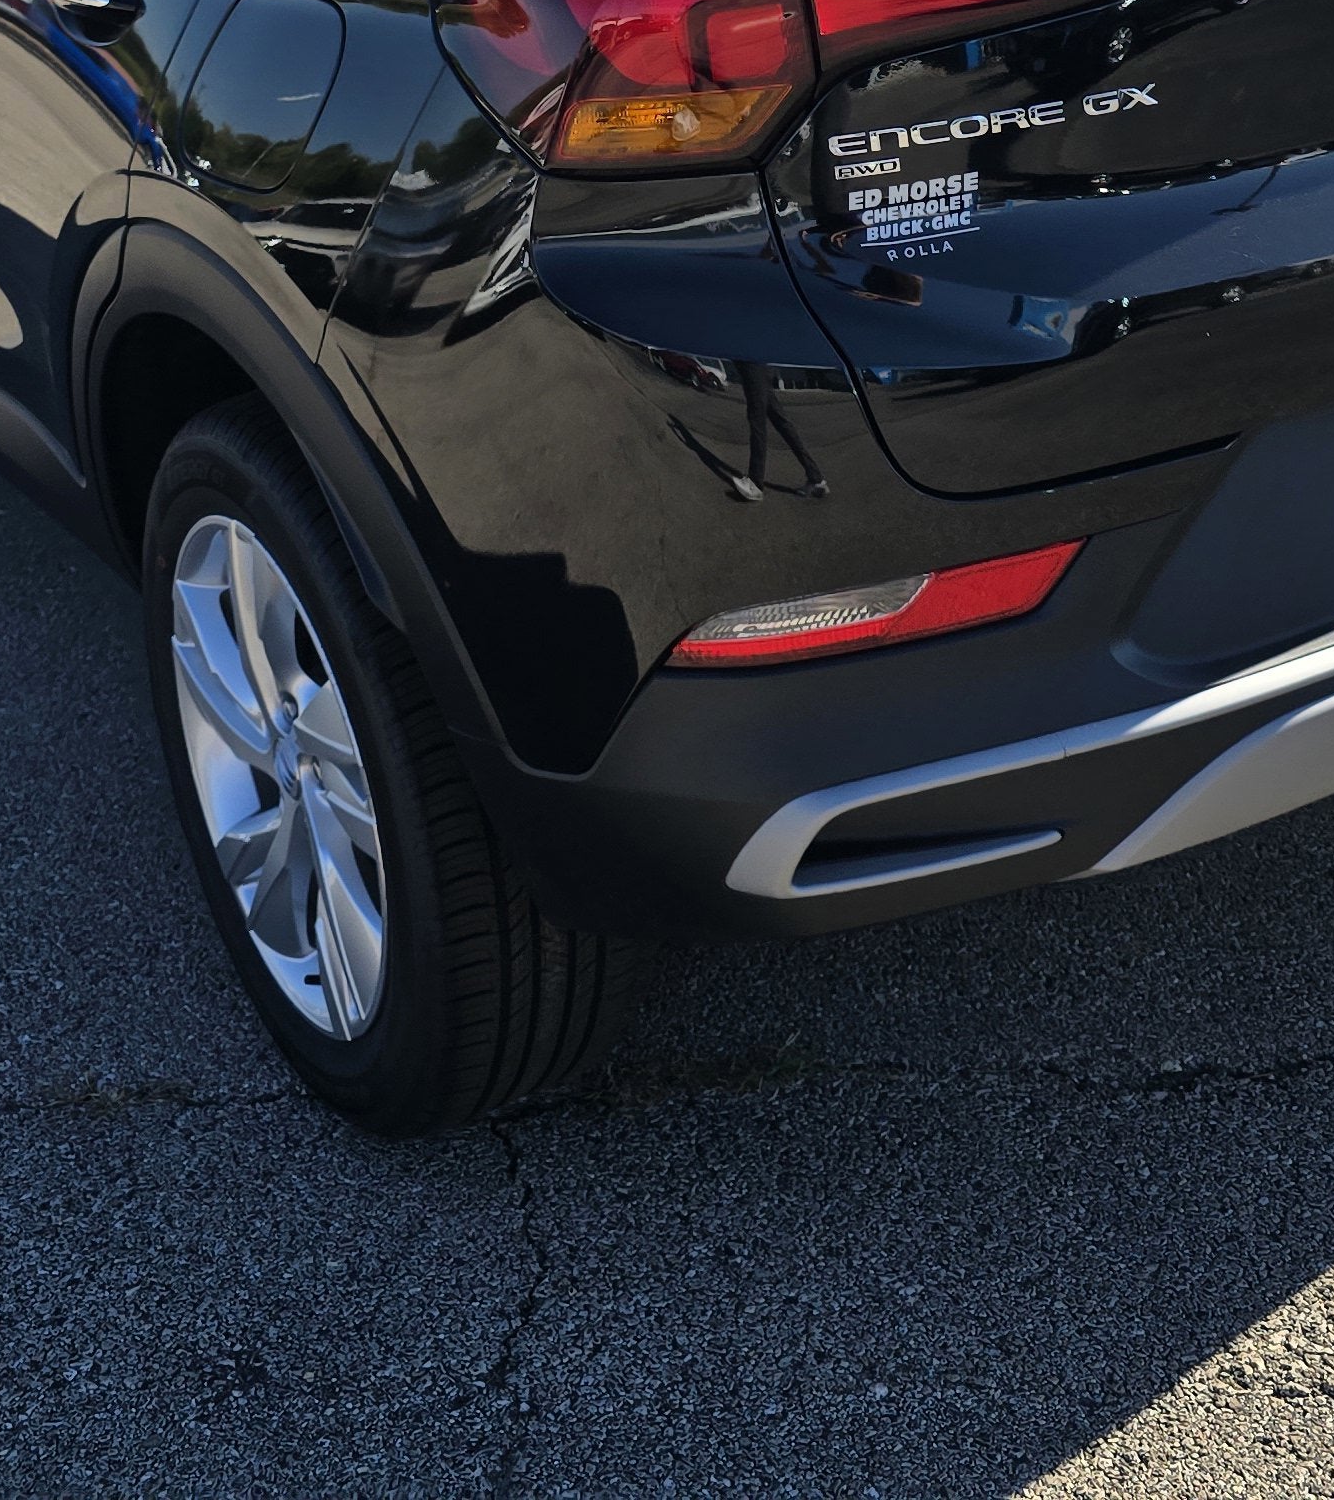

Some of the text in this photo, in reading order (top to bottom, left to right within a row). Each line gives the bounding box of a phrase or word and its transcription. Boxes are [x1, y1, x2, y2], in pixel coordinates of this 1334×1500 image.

[828, 82, 1159, 157] ENCORE GX
[836, 160, 899, 179] AWD
[848, 171, 979, 211] ED MORSE
[861, 193, 973, 226] CHEVROLET
[886, 240, 954, 262] ROLLA
